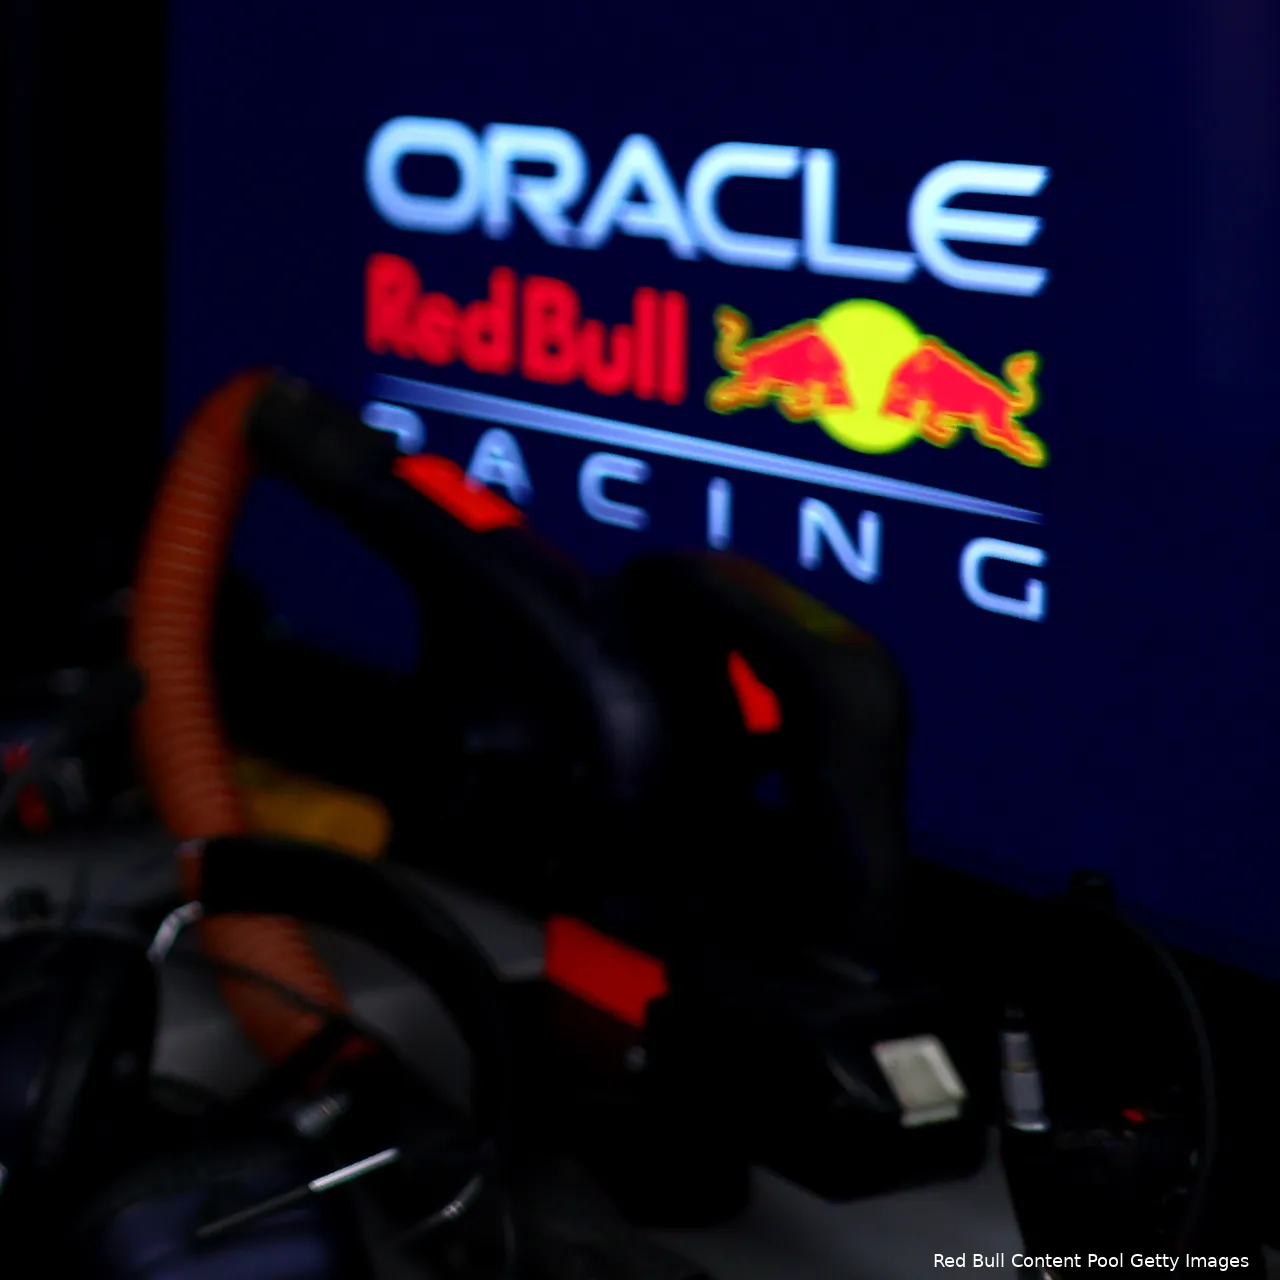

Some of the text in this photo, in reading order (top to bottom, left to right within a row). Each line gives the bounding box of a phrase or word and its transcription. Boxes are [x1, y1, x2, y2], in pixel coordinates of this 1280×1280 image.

[364, 114, 1051, 298] ORACLE
[364, 252, 689, 406] Red Bull
